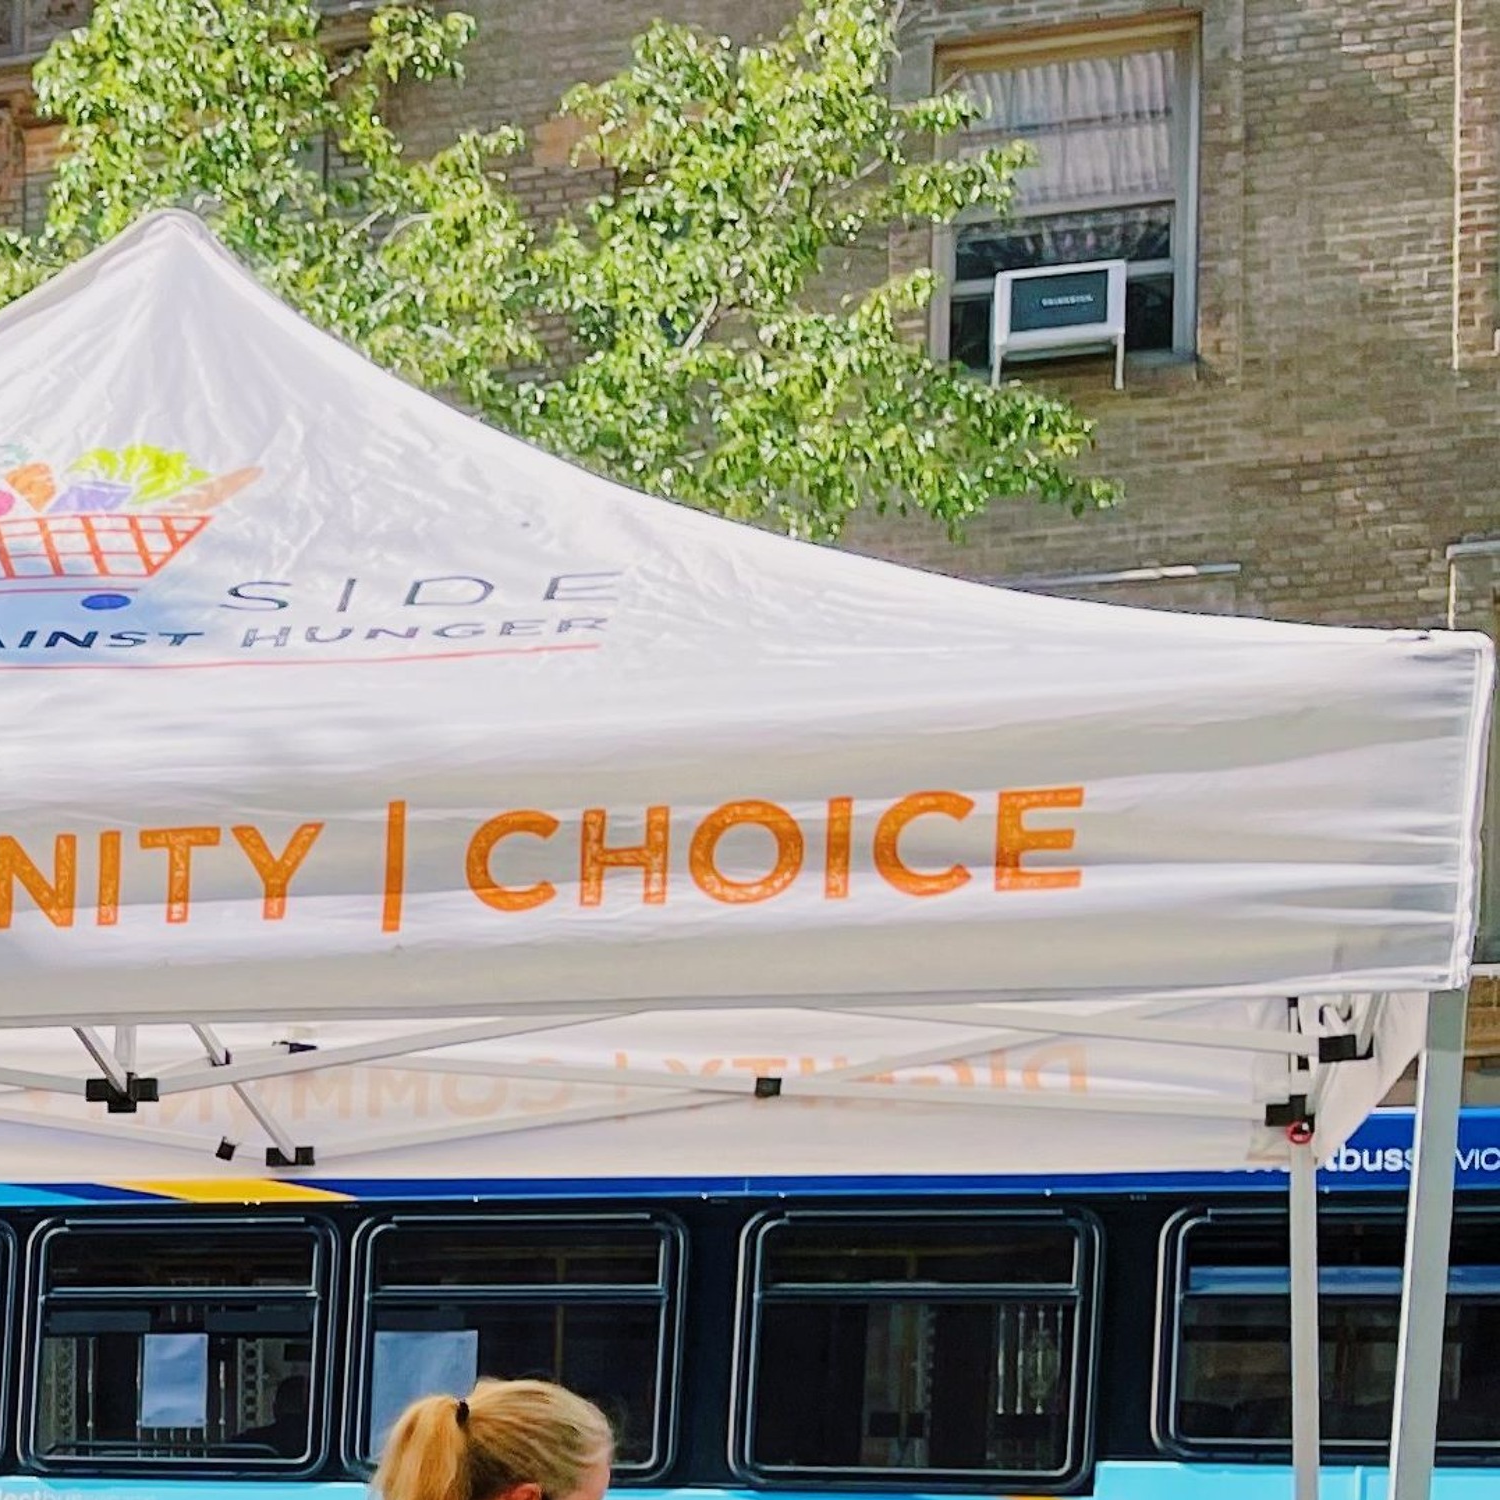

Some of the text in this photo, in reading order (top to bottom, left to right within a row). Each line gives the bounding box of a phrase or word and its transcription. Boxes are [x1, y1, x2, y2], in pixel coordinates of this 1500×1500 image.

[219, 572, 624, 613] SIDE
[240, 616, 610, 648] HUNGER
[464, 784, 1084, 912] CHOICE
